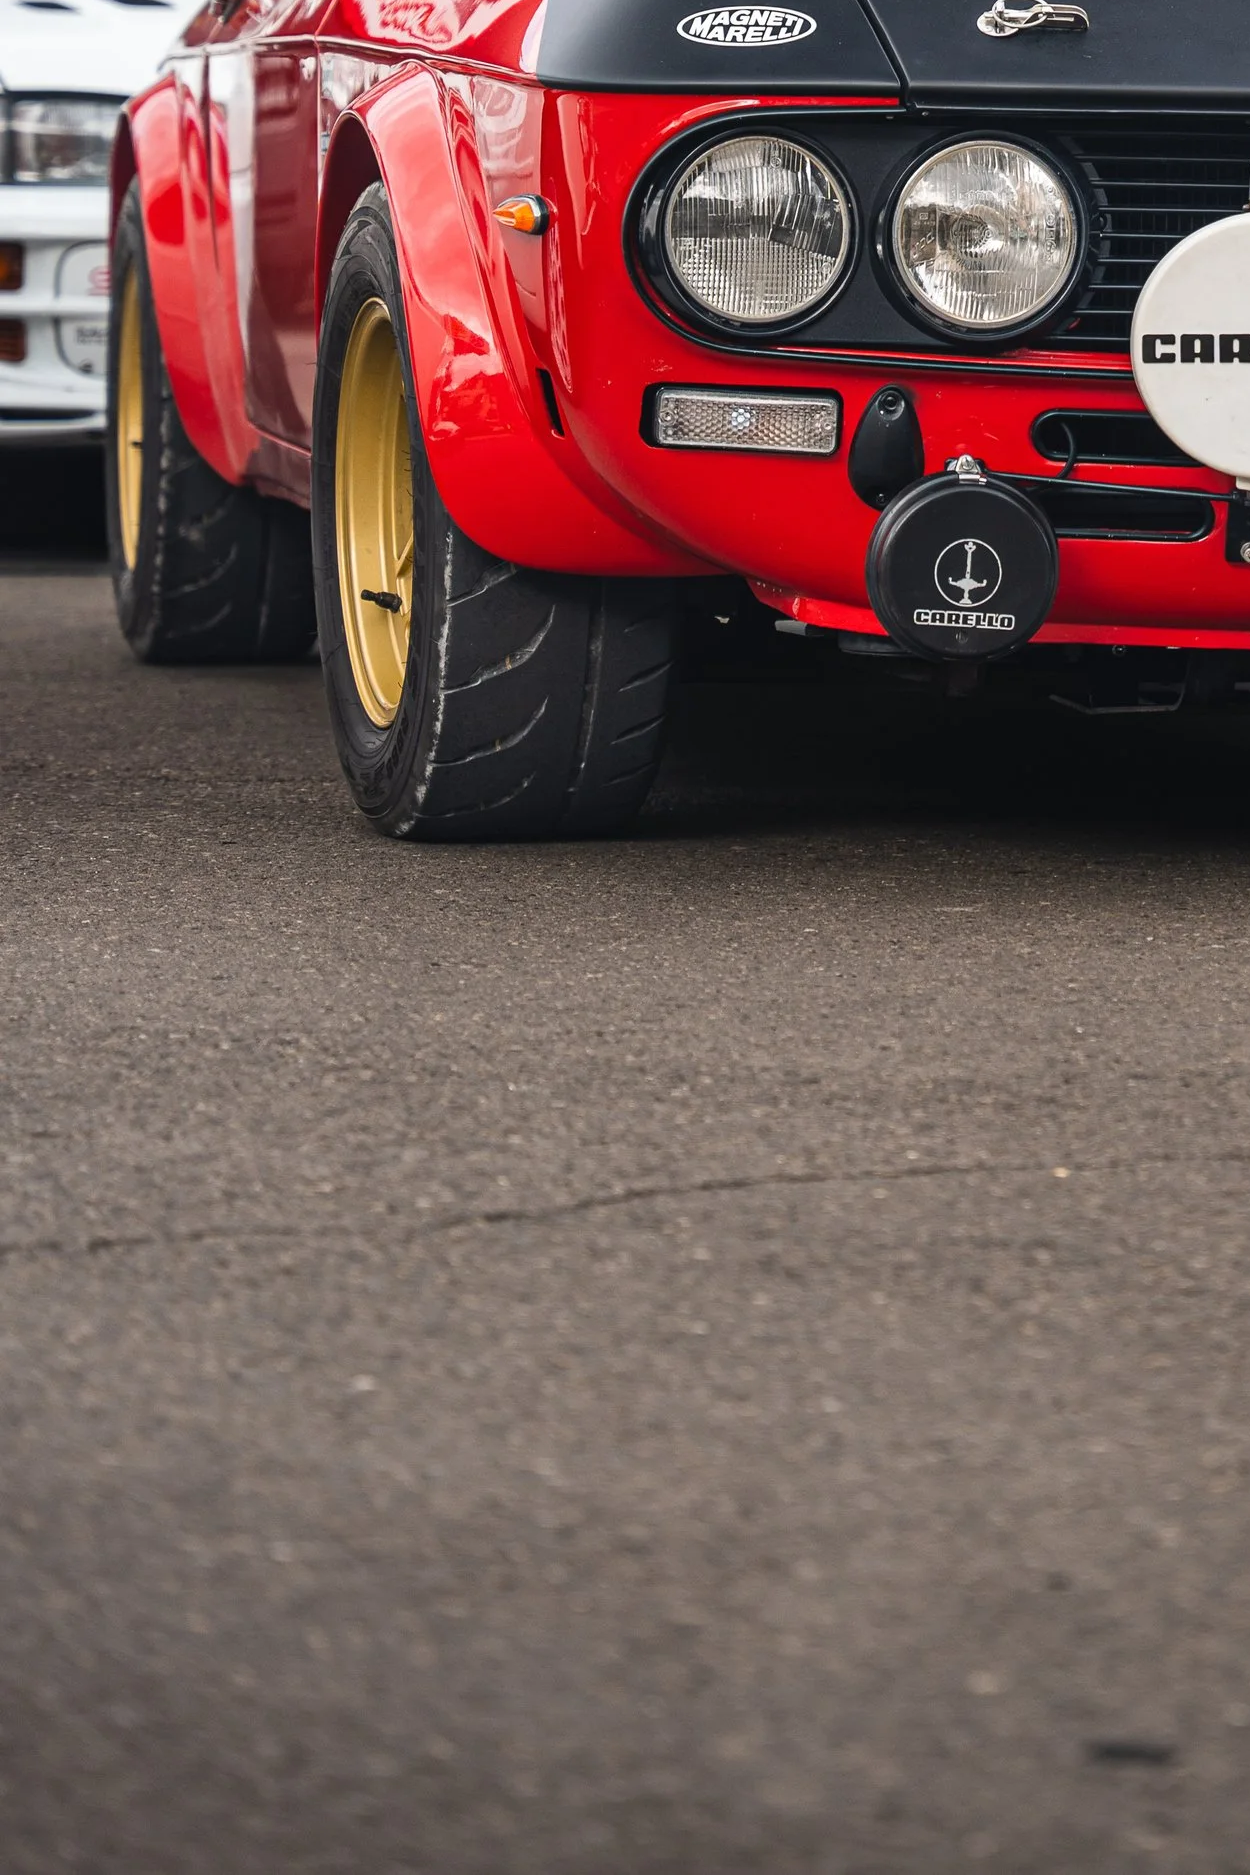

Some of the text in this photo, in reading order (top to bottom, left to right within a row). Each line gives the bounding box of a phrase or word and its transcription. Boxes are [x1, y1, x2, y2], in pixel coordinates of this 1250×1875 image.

[690, 10, 804, 29] MAGNETI
[689, 24, 801, 42] MARELLI
[914, 609, 1015, 630] CARELLO
